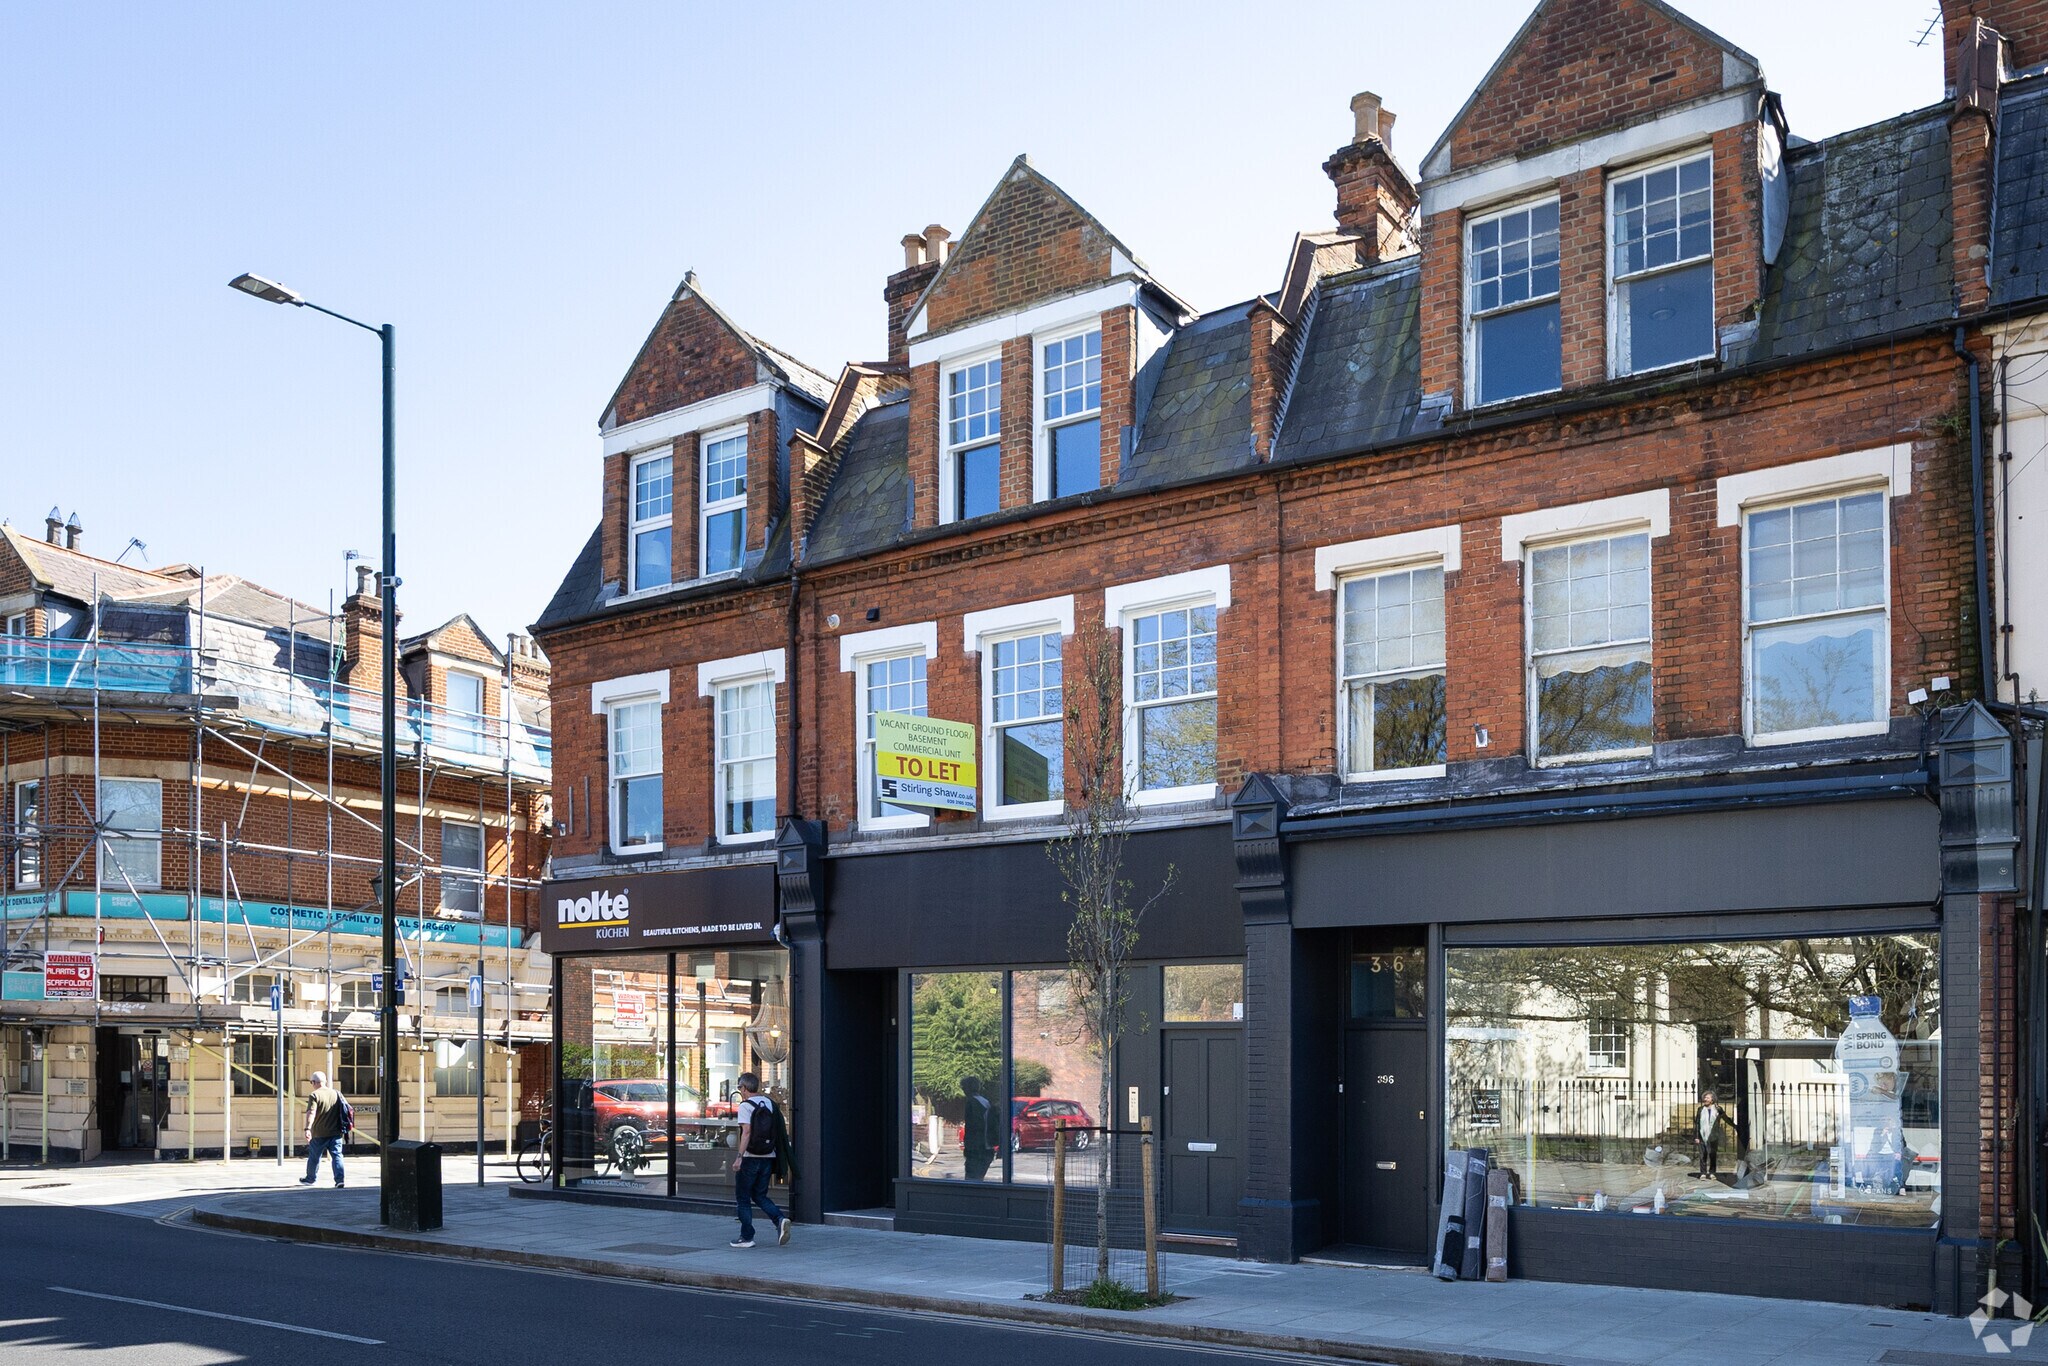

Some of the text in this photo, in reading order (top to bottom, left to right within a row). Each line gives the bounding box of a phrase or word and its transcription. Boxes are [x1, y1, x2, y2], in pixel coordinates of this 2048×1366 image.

[880, 718, 972, 740] VACANT GROUND FLOOR/
[908, 734, 947, 746] BASEMENT
[894, 742, 961, 758] COMMERCIAL UNIT
[896, 756, 960, 782] TO LET
[901, 783, 932, 797] Stirling
[12, 897, 31, 906] DENTAL
[32, 895, 56, 904] SURGY
[558, 890, 629, 922] nolte
[270, 907, 324, 919] COSMETIC
[336, 914, 371, 923] FAMILY
[596, 927, 629, 938] KÜCHEN
[643, 928, 672, 936] BEAUTIFUL
[672, 926, 700, 936] KITCHENS,
[702, 925, 718, 933] MADE
[719, 924, 728, 932] TO
[736, 923, 752, 931] LIVED
[47, 979, 92, 987] SCAFFOLDING
[1856, 1032, 1886, 1040] SPRING
[1856, 1041, 1884, 1049] BOND
[1377, 1075, 1394, 1084] 396
[252, 1139, 260, 1148] H
